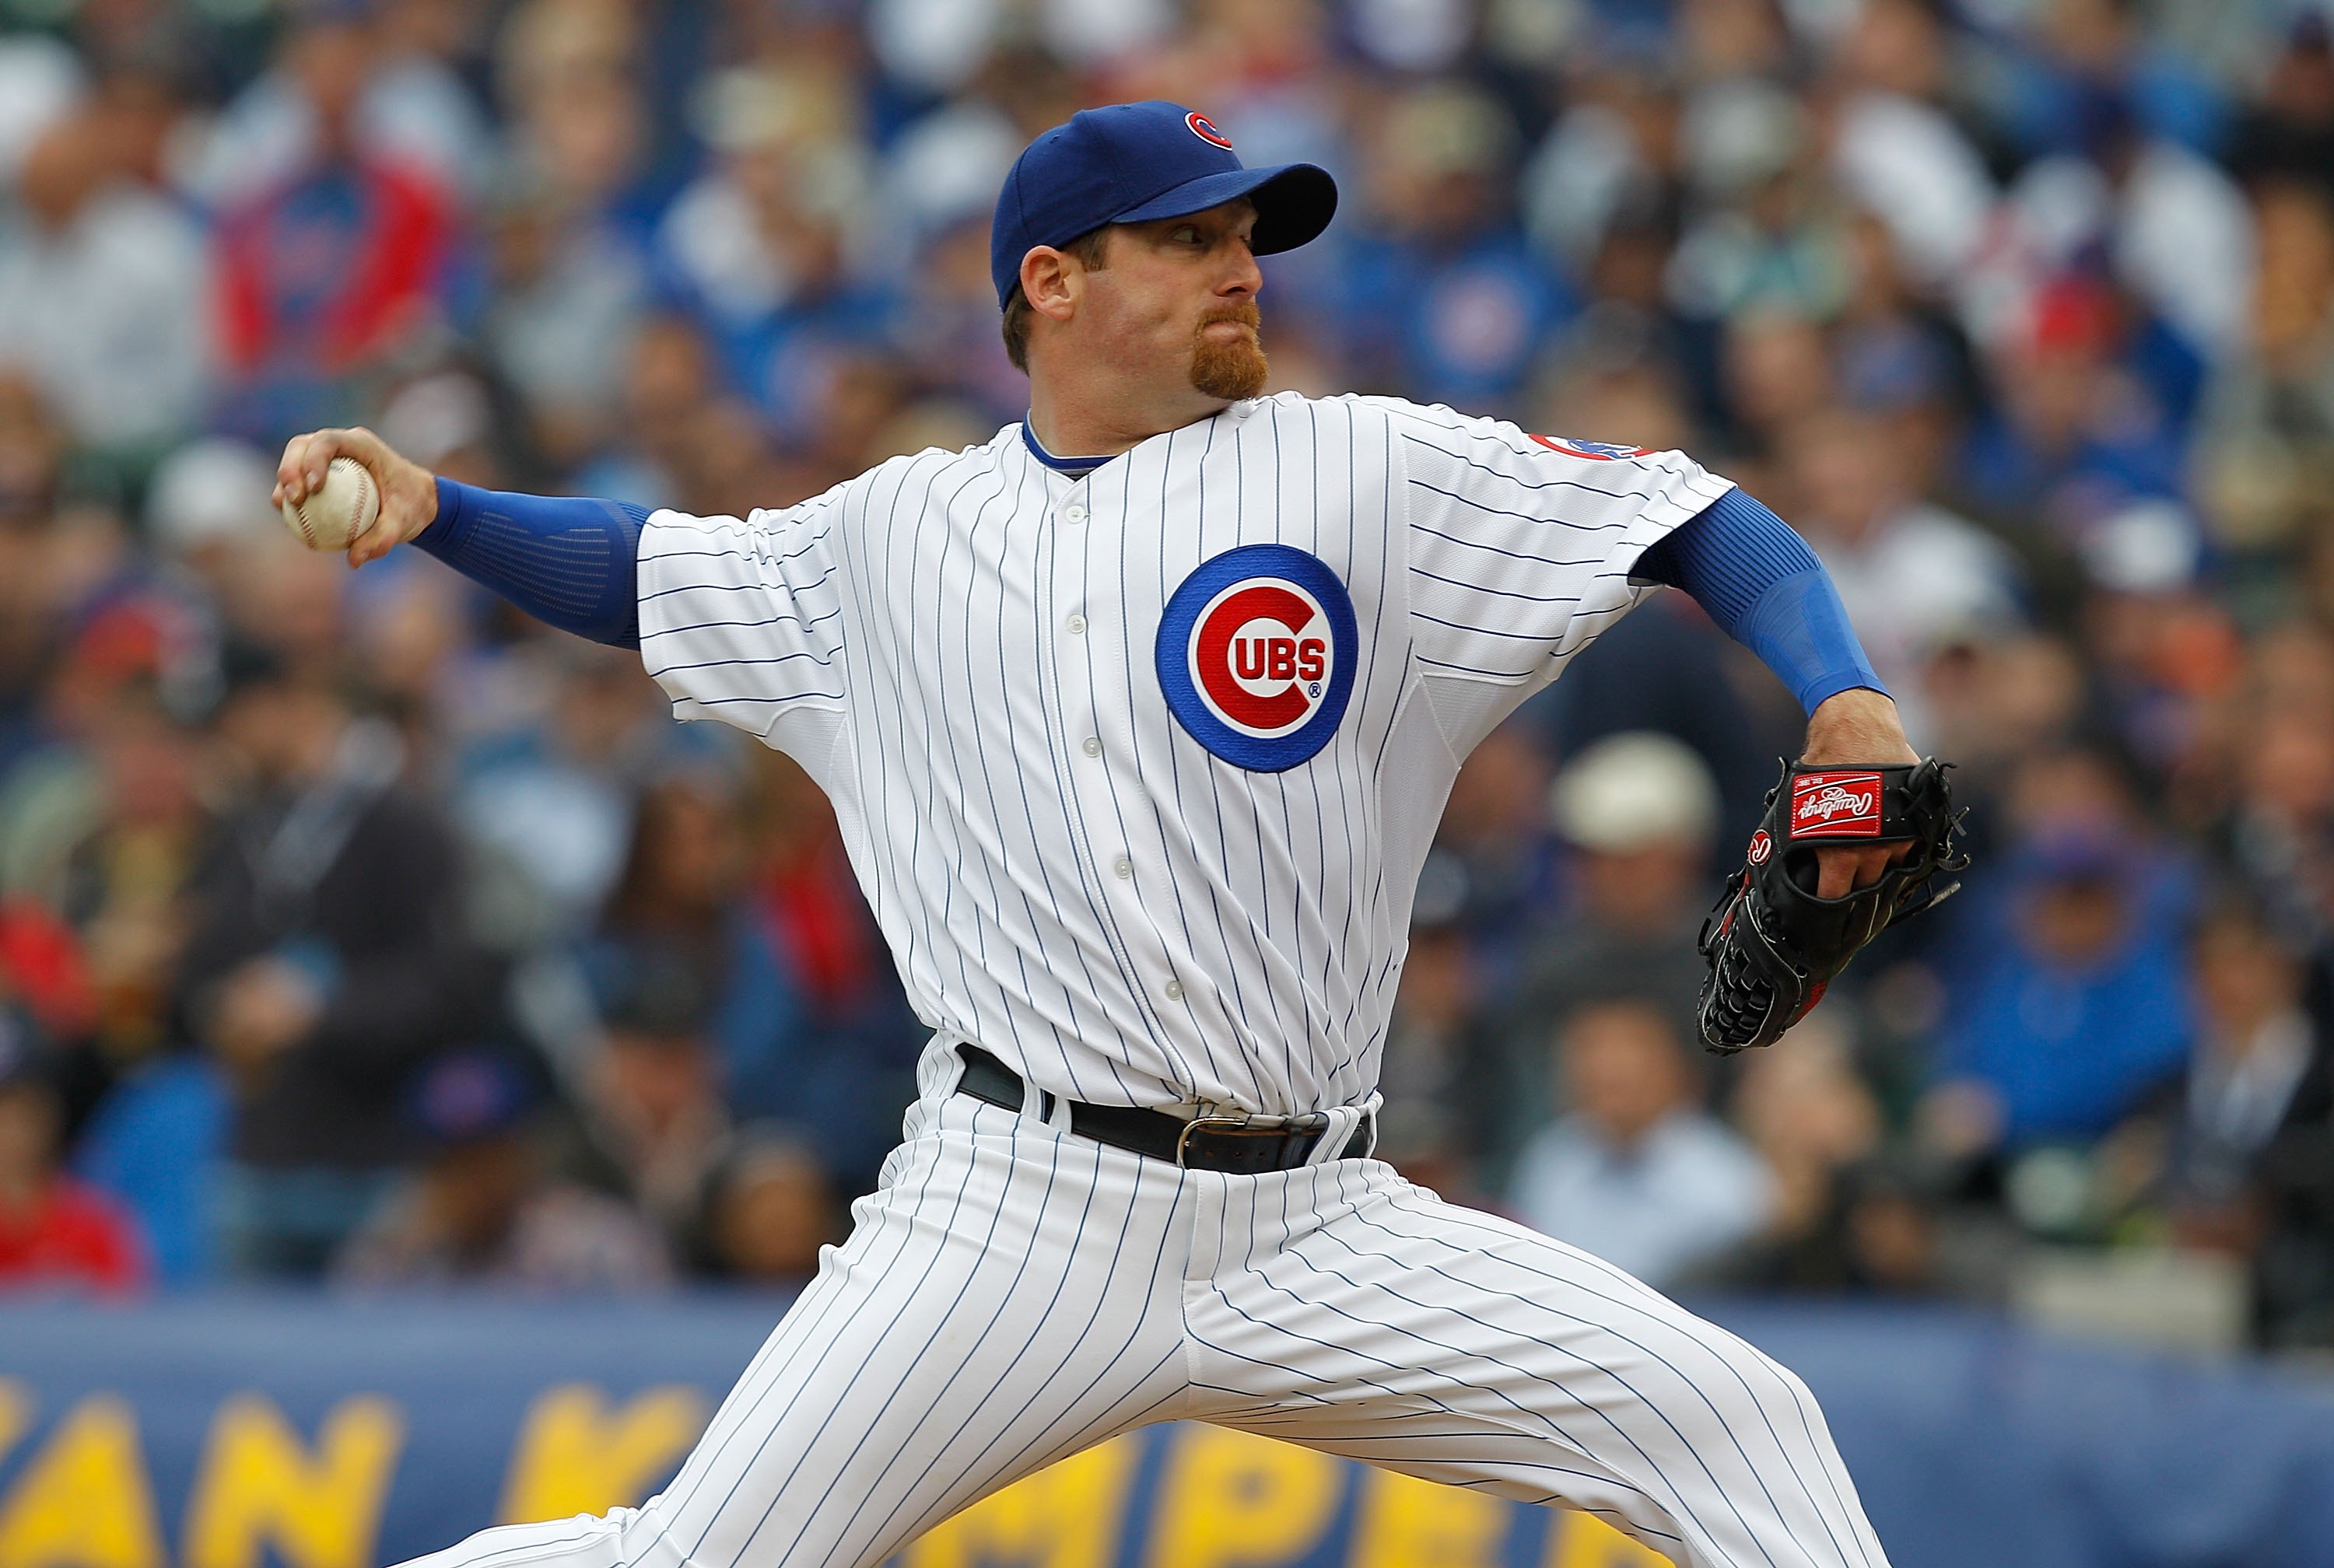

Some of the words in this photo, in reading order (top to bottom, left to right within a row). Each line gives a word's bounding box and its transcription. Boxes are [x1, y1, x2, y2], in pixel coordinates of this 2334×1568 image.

[1184, 112, 1232, 150] C
[1197, 586, 1325, 729] CUBS
[1798, 793, 1873, 820] Rawlings
[0, 1377, 405, 1568] AN
